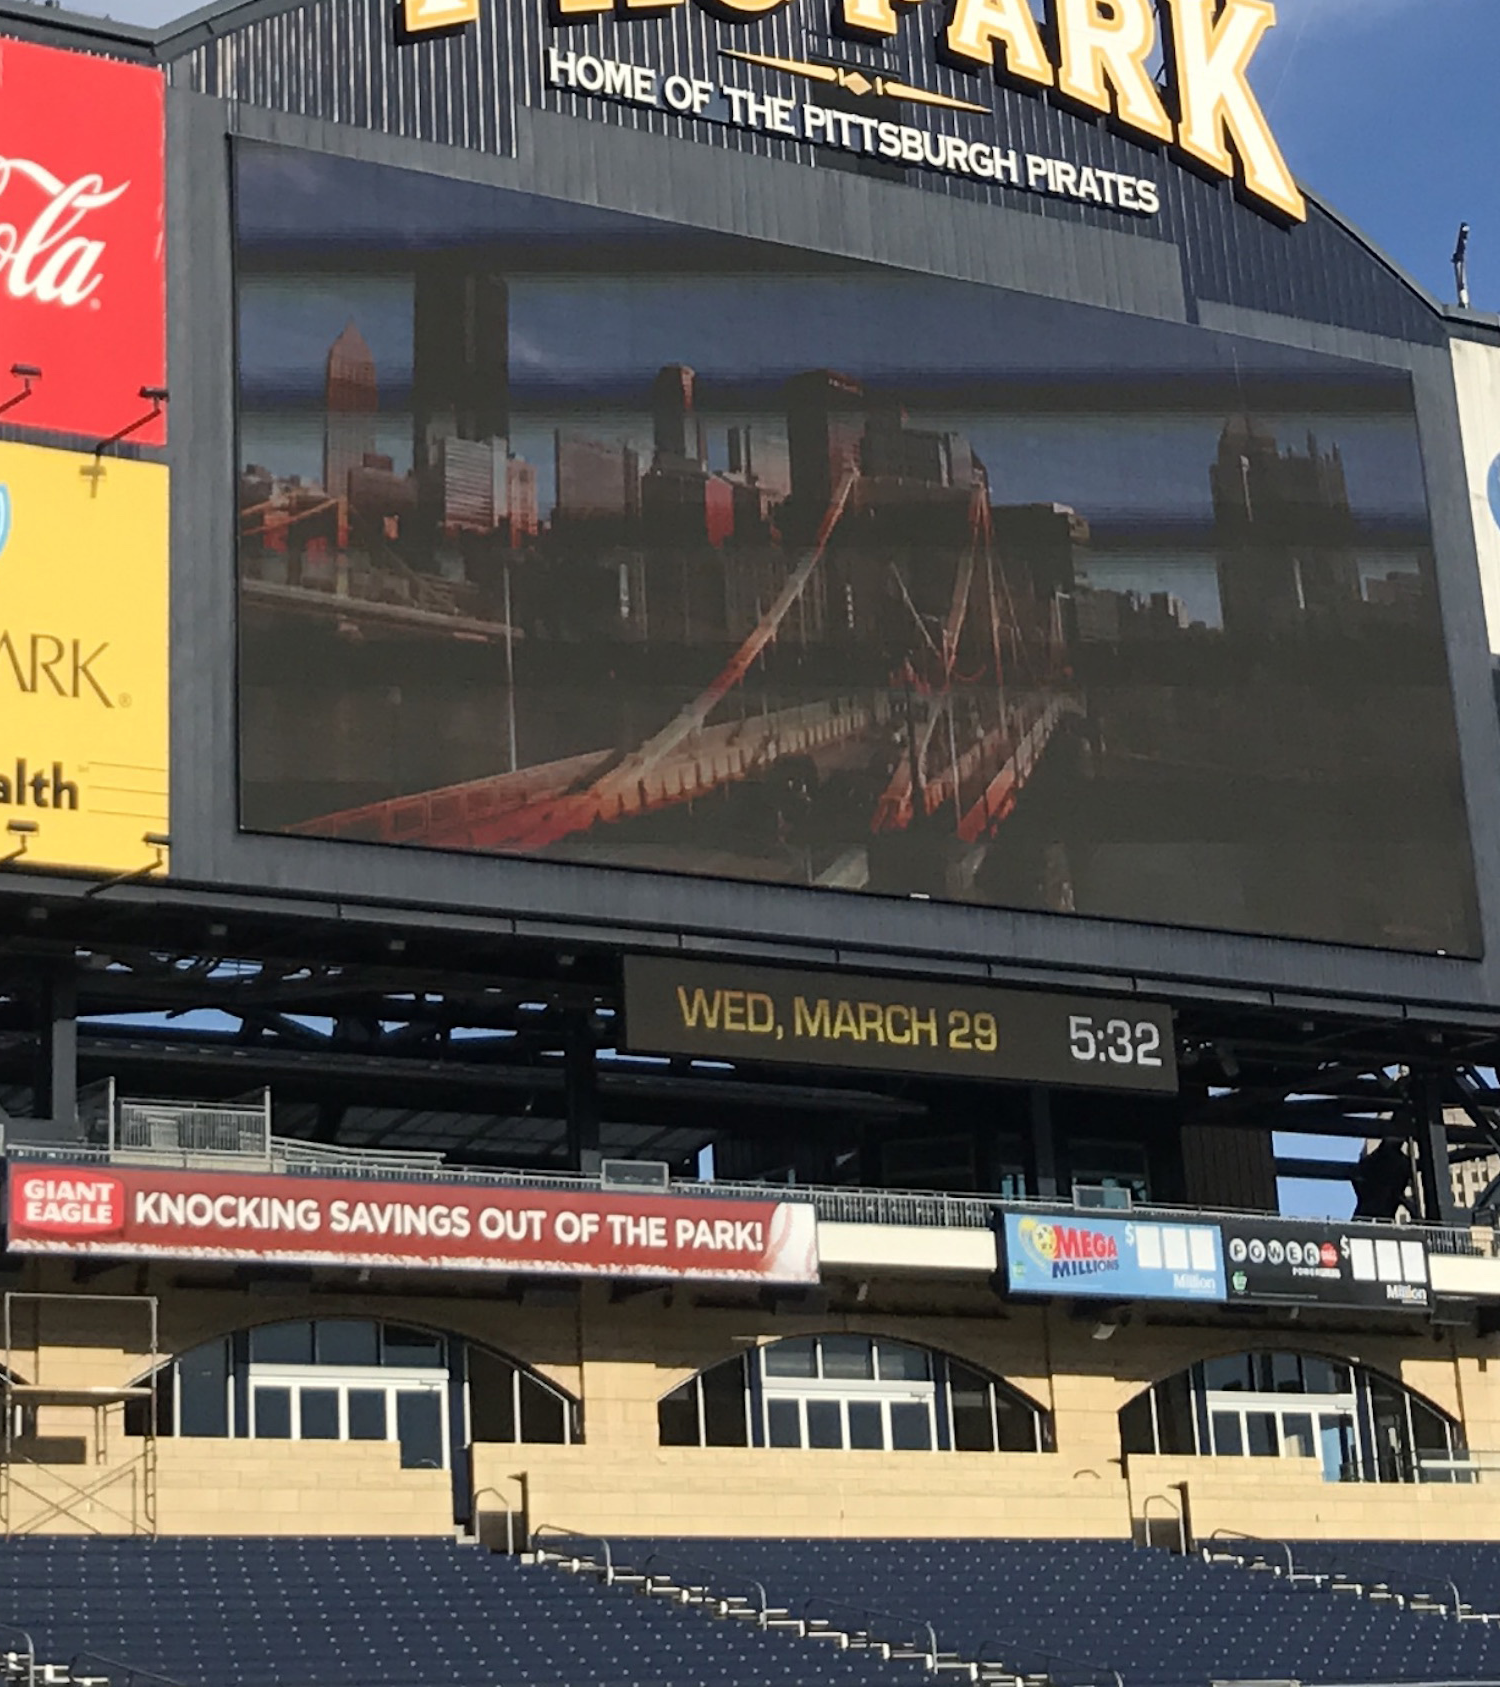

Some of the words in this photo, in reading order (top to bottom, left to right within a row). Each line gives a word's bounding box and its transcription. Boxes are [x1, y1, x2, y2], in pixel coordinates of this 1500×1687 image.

[548, 47, 657, 106] HOME
[664, 75, 713, 114] OF
[722, 85, 796, 135] THE
[802, 103, 1019, 185] PITTSBURGH
[1025, 153, 1160, 214] PIRATES
[677, 985, 785, 1042] WED,
[794, 996, 938, 1048] MARCH
[948, 1010, 998, 1052] 29
[1068, 1015, 1163, 1067] 5:32
[23, 1178, 115, 1203] GIANT
[26, 1201, 113, 1225] EAGLE
[135, 1191, 321, 1232] KNOCKING
[329, 1199, 470, 1238] SAVINGS
[478, 1206, 547, 1241] OUT
[554, 1211, 600, 1244] OF
[606, 1214, 668, 1248] THE
[674, 1218, 764, 1253] PARK!
[1053, 1224, 1119, 1260] MEGA
[1052, 1259, 1120, 1279] MILLIONS
